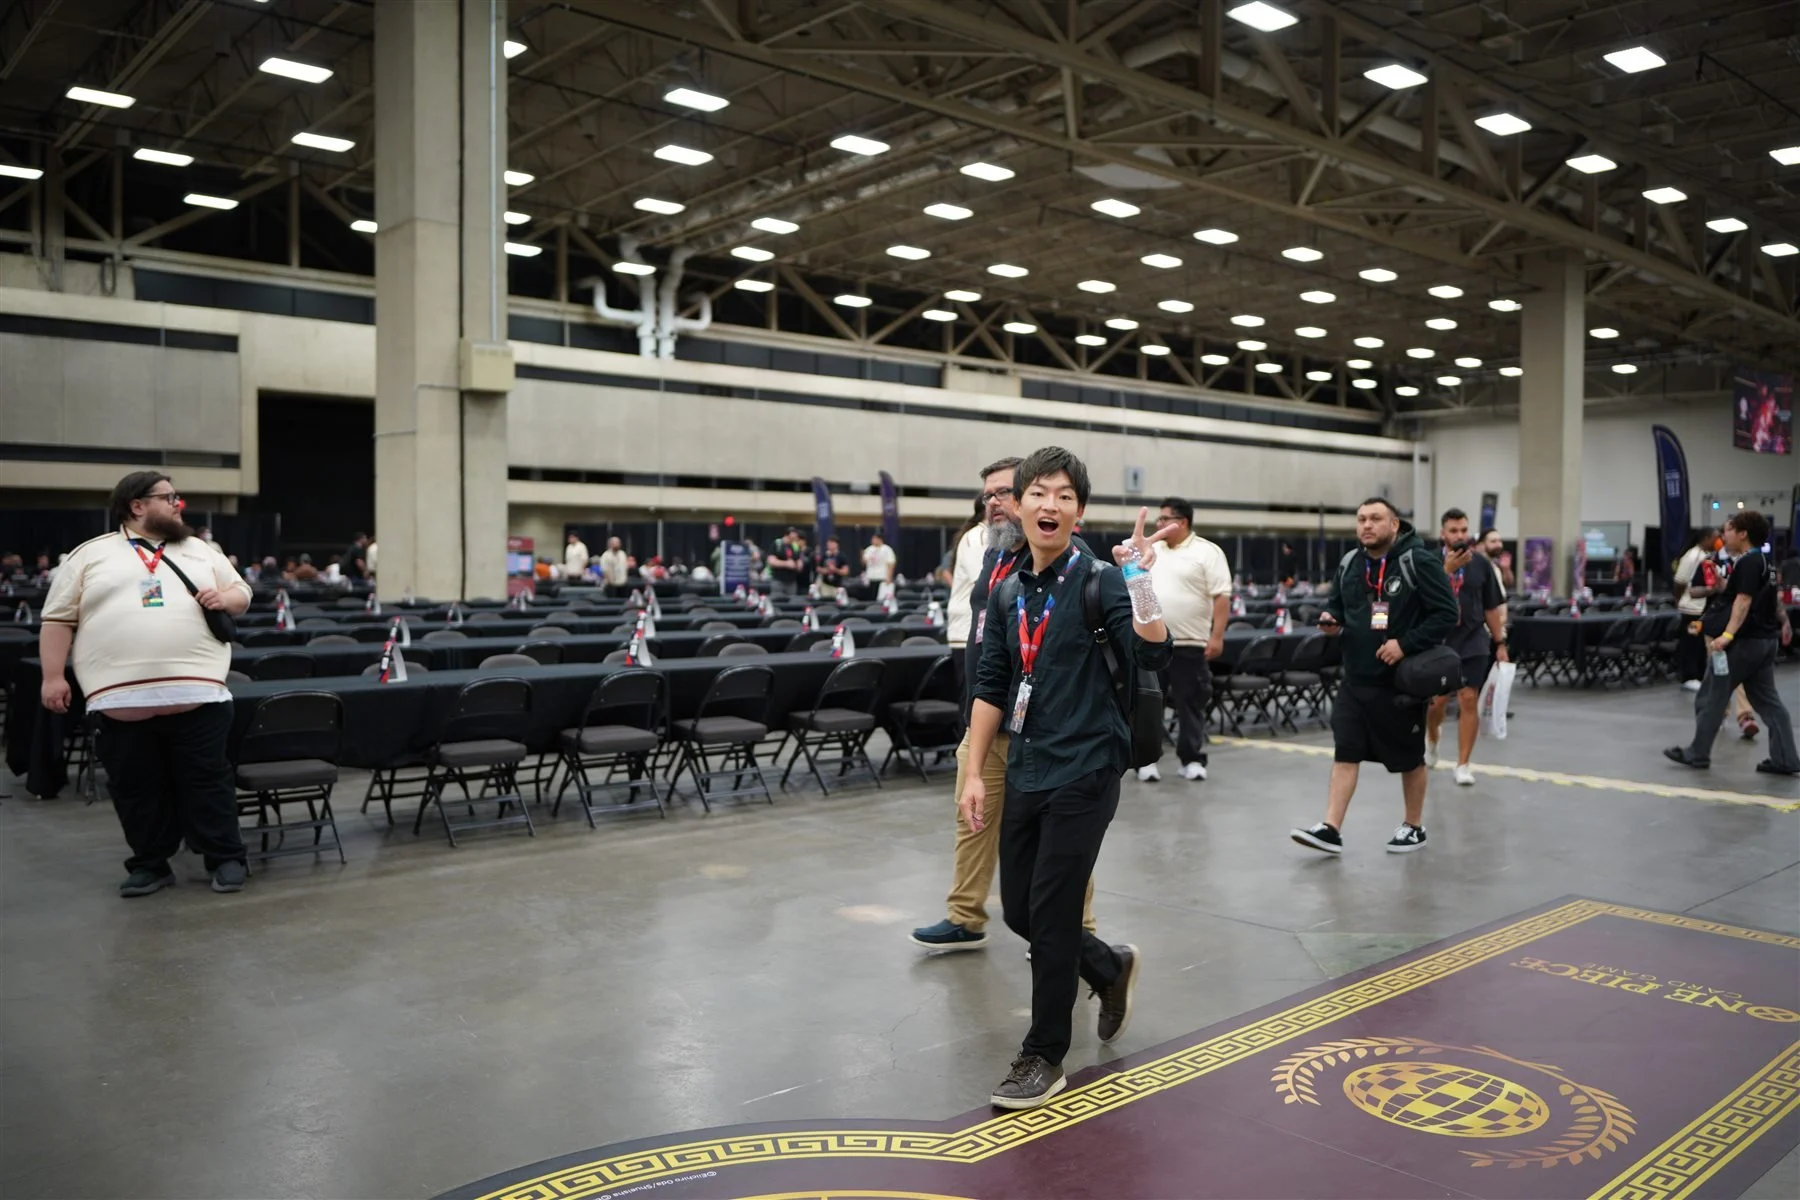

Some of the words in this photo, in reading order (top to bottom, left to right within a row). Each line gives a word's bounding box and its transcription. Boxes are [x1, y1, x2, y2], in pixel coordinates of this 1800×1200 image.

[1509, 956, 1664, 995] PIECE
[1579, 962, 1657, 982] GAME
[1667, 980, 1742, 999] CARD
[1663, 988, 1800, 1023] ONE
